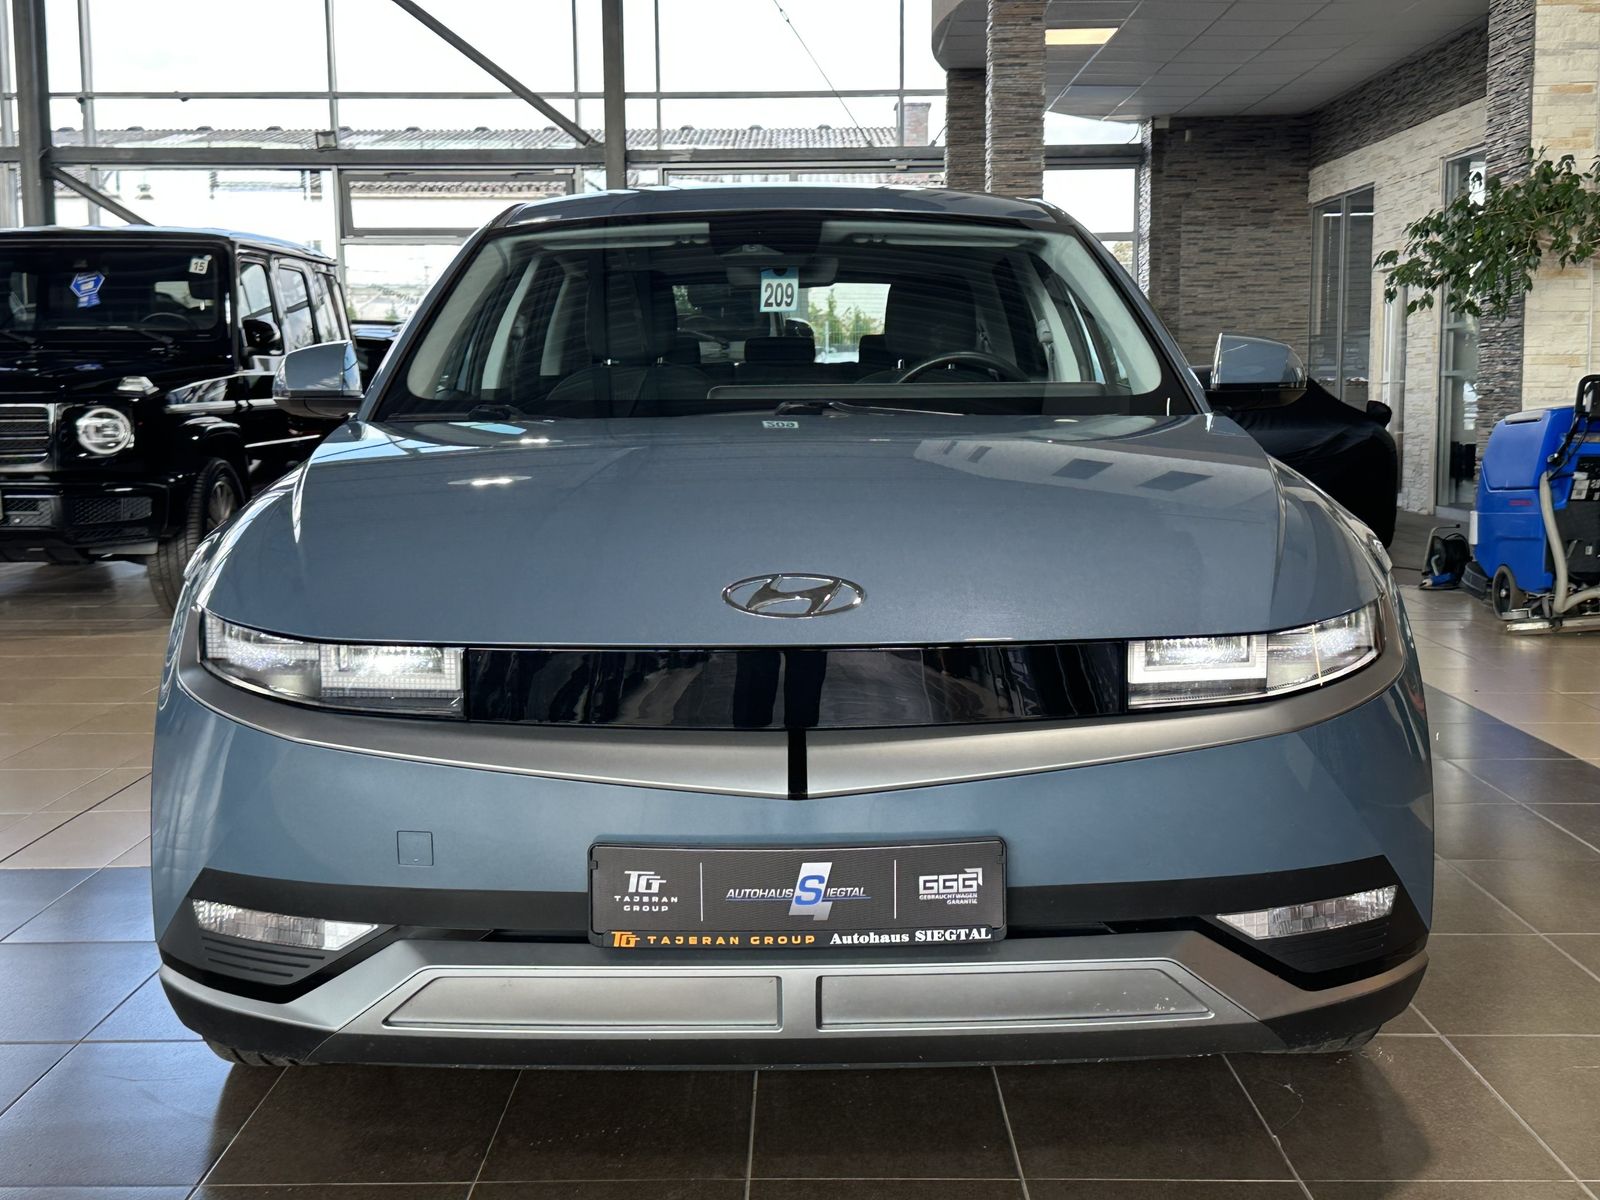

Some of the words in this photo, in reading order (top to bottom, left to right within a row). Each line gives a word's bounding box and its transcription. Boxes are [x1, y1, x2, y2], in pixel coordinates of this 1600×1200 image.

[193, 261, 205, 272] 15
[763, 282, 795, 308] 209
[918, 872, 978, 894] GGG
[613, 895, 678, 903] TAJERAN
[726, 888, 793, 899] AUTOHAUS
[918, 892, 978, 900] GEBRAUCHTWAGEN
[647, 935, 739, 945] TAJERAN
[750, 935, 815, 945] GROUP
[829, 932, 910, 945] Autohaus
[914, 927, 992, 942] SIEGTAL
